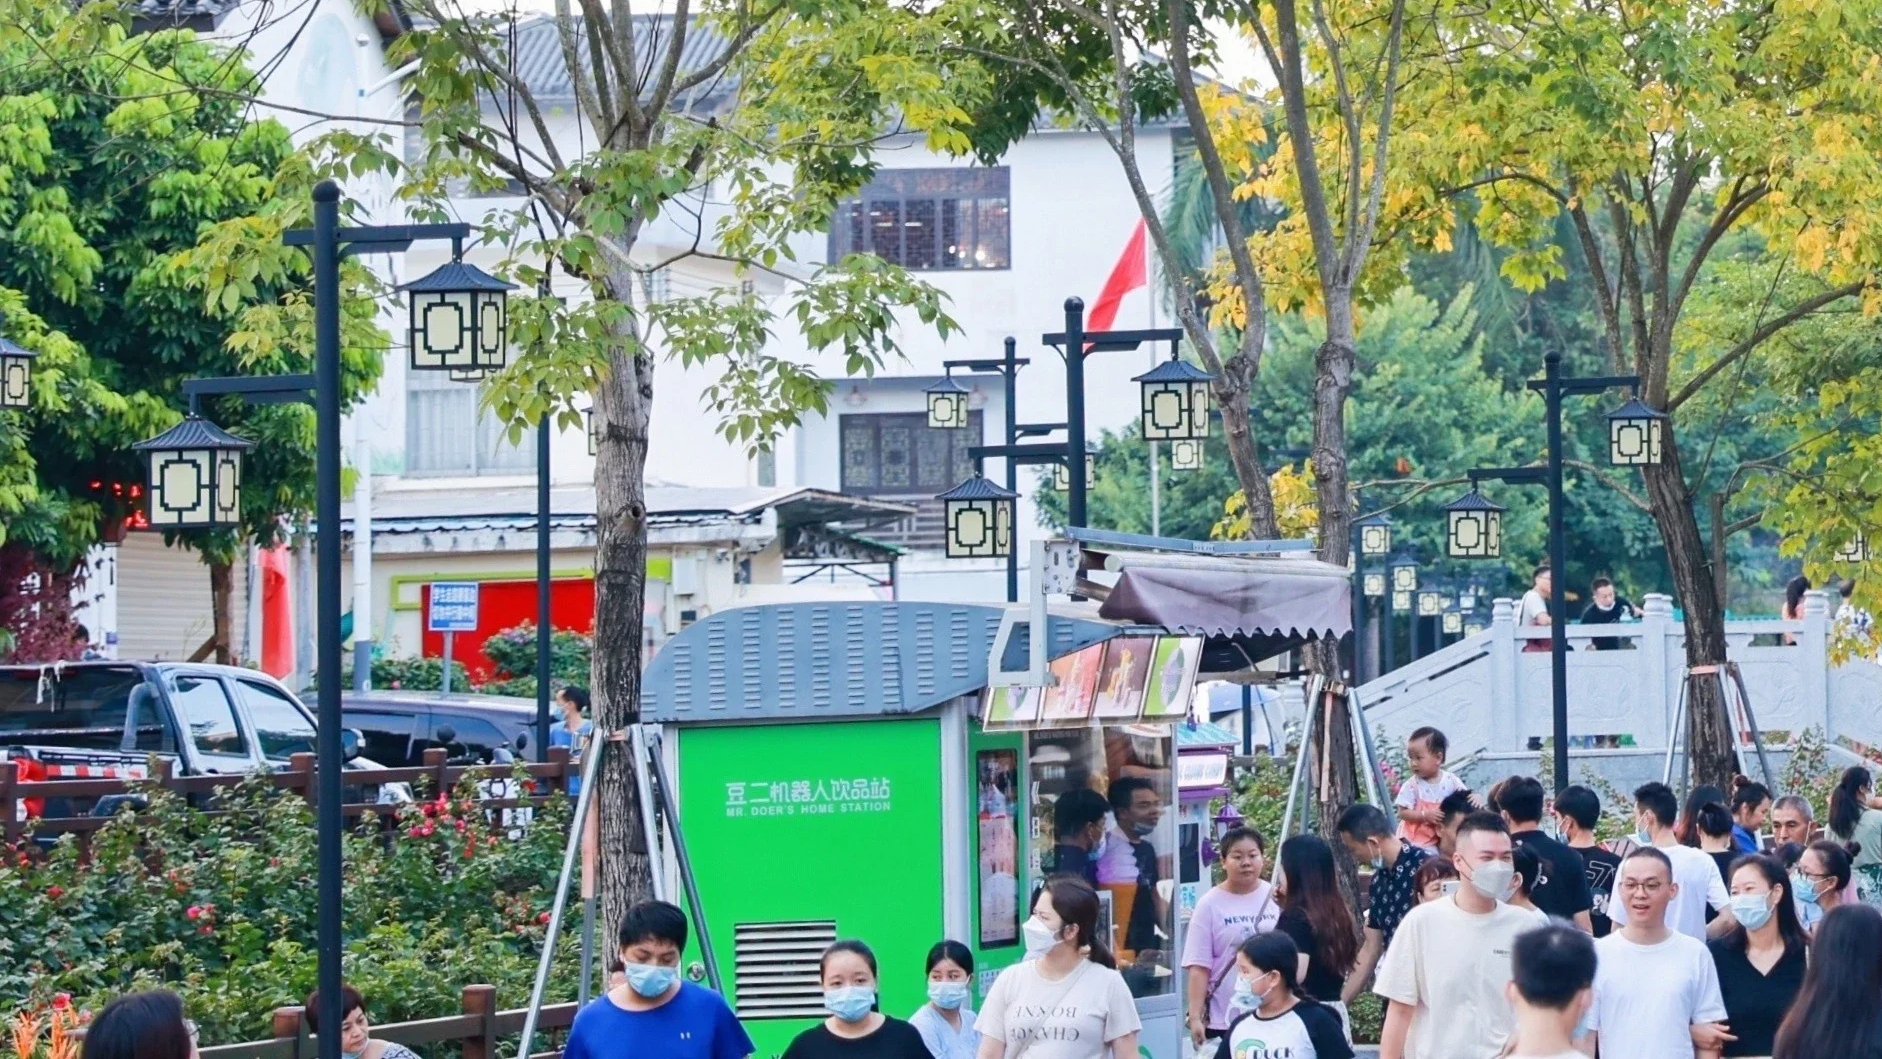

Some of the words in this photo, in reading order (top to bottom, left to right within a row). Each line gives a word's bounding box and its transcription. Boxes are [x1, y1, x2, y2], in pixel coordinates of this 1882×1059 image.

[725, 777, 891, 805] 豆二机器人饮品站
[726, 807, 747, 817] MR.
[752, 805, 795, 816] DOER'S
[801, 803, 835, 814] HOME
[840, 801, 891, 812] STATION
